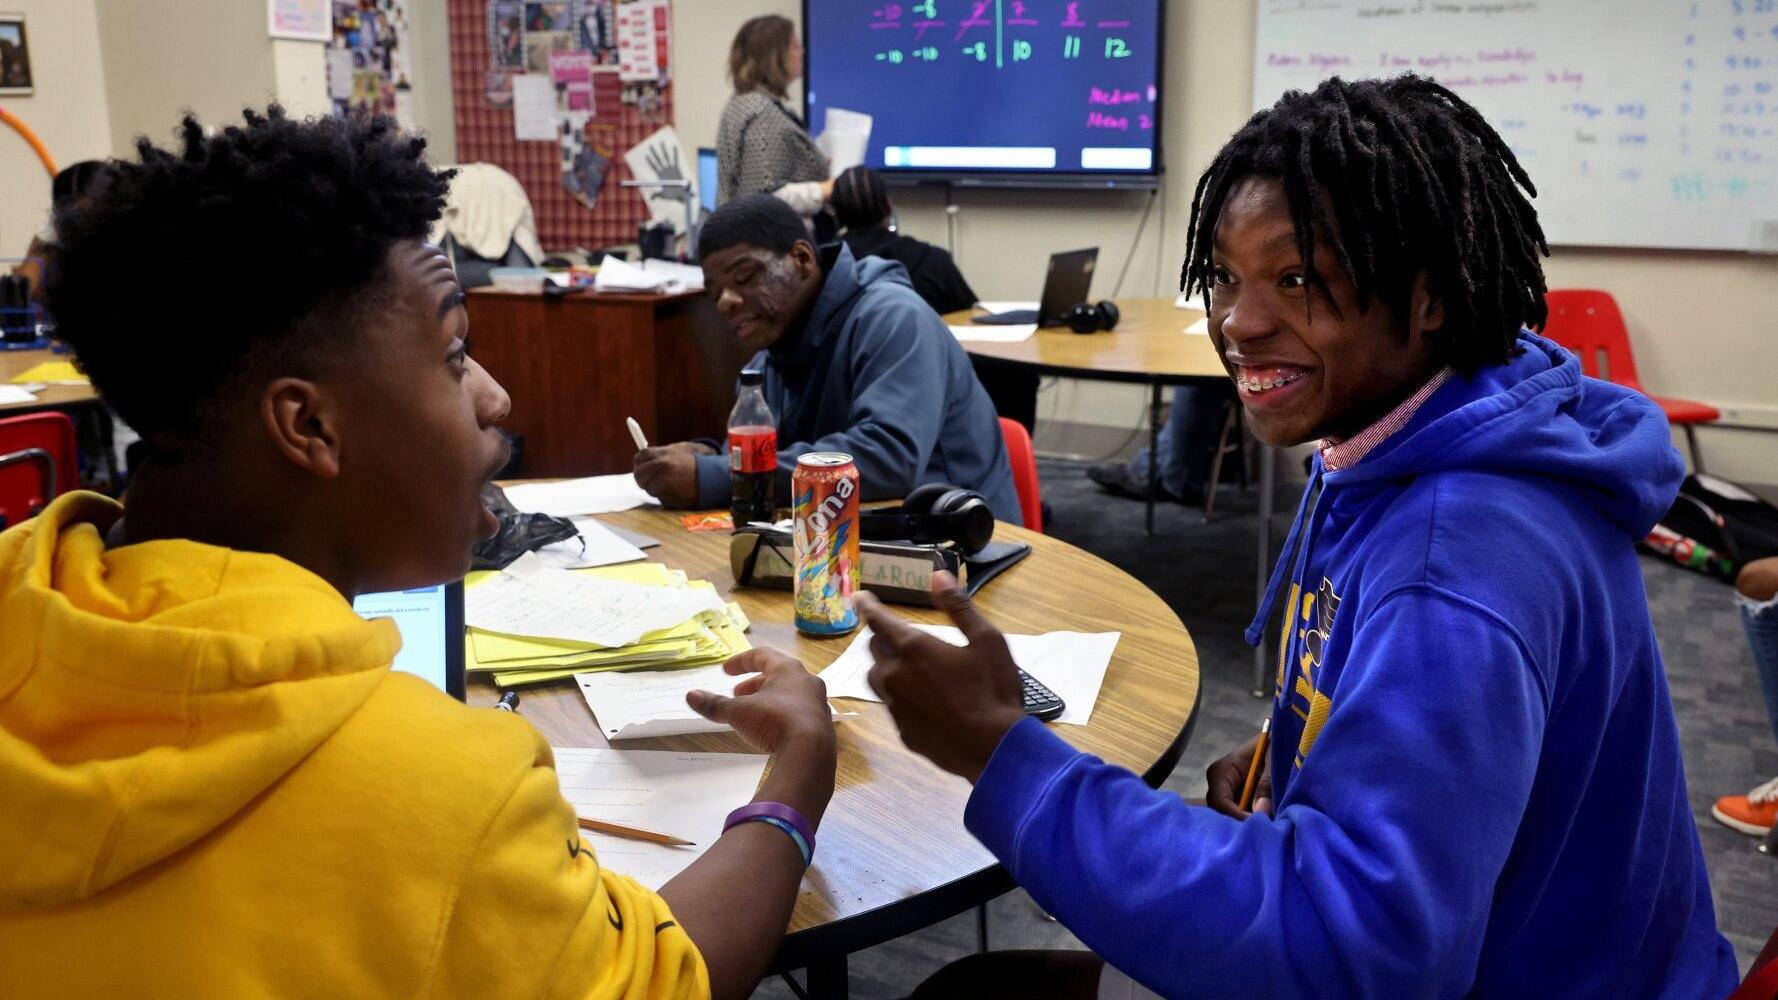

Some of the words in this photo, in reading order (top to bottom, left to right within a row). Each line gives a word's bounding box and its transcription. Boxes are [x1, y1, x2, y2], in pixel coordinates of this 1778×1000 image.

[962, 41, 987, 61] -8
[1013, 39, 1032, 62] 10
[1064, 35, 1081, 59] 11
[1104, 36, 1132, 59] 12
